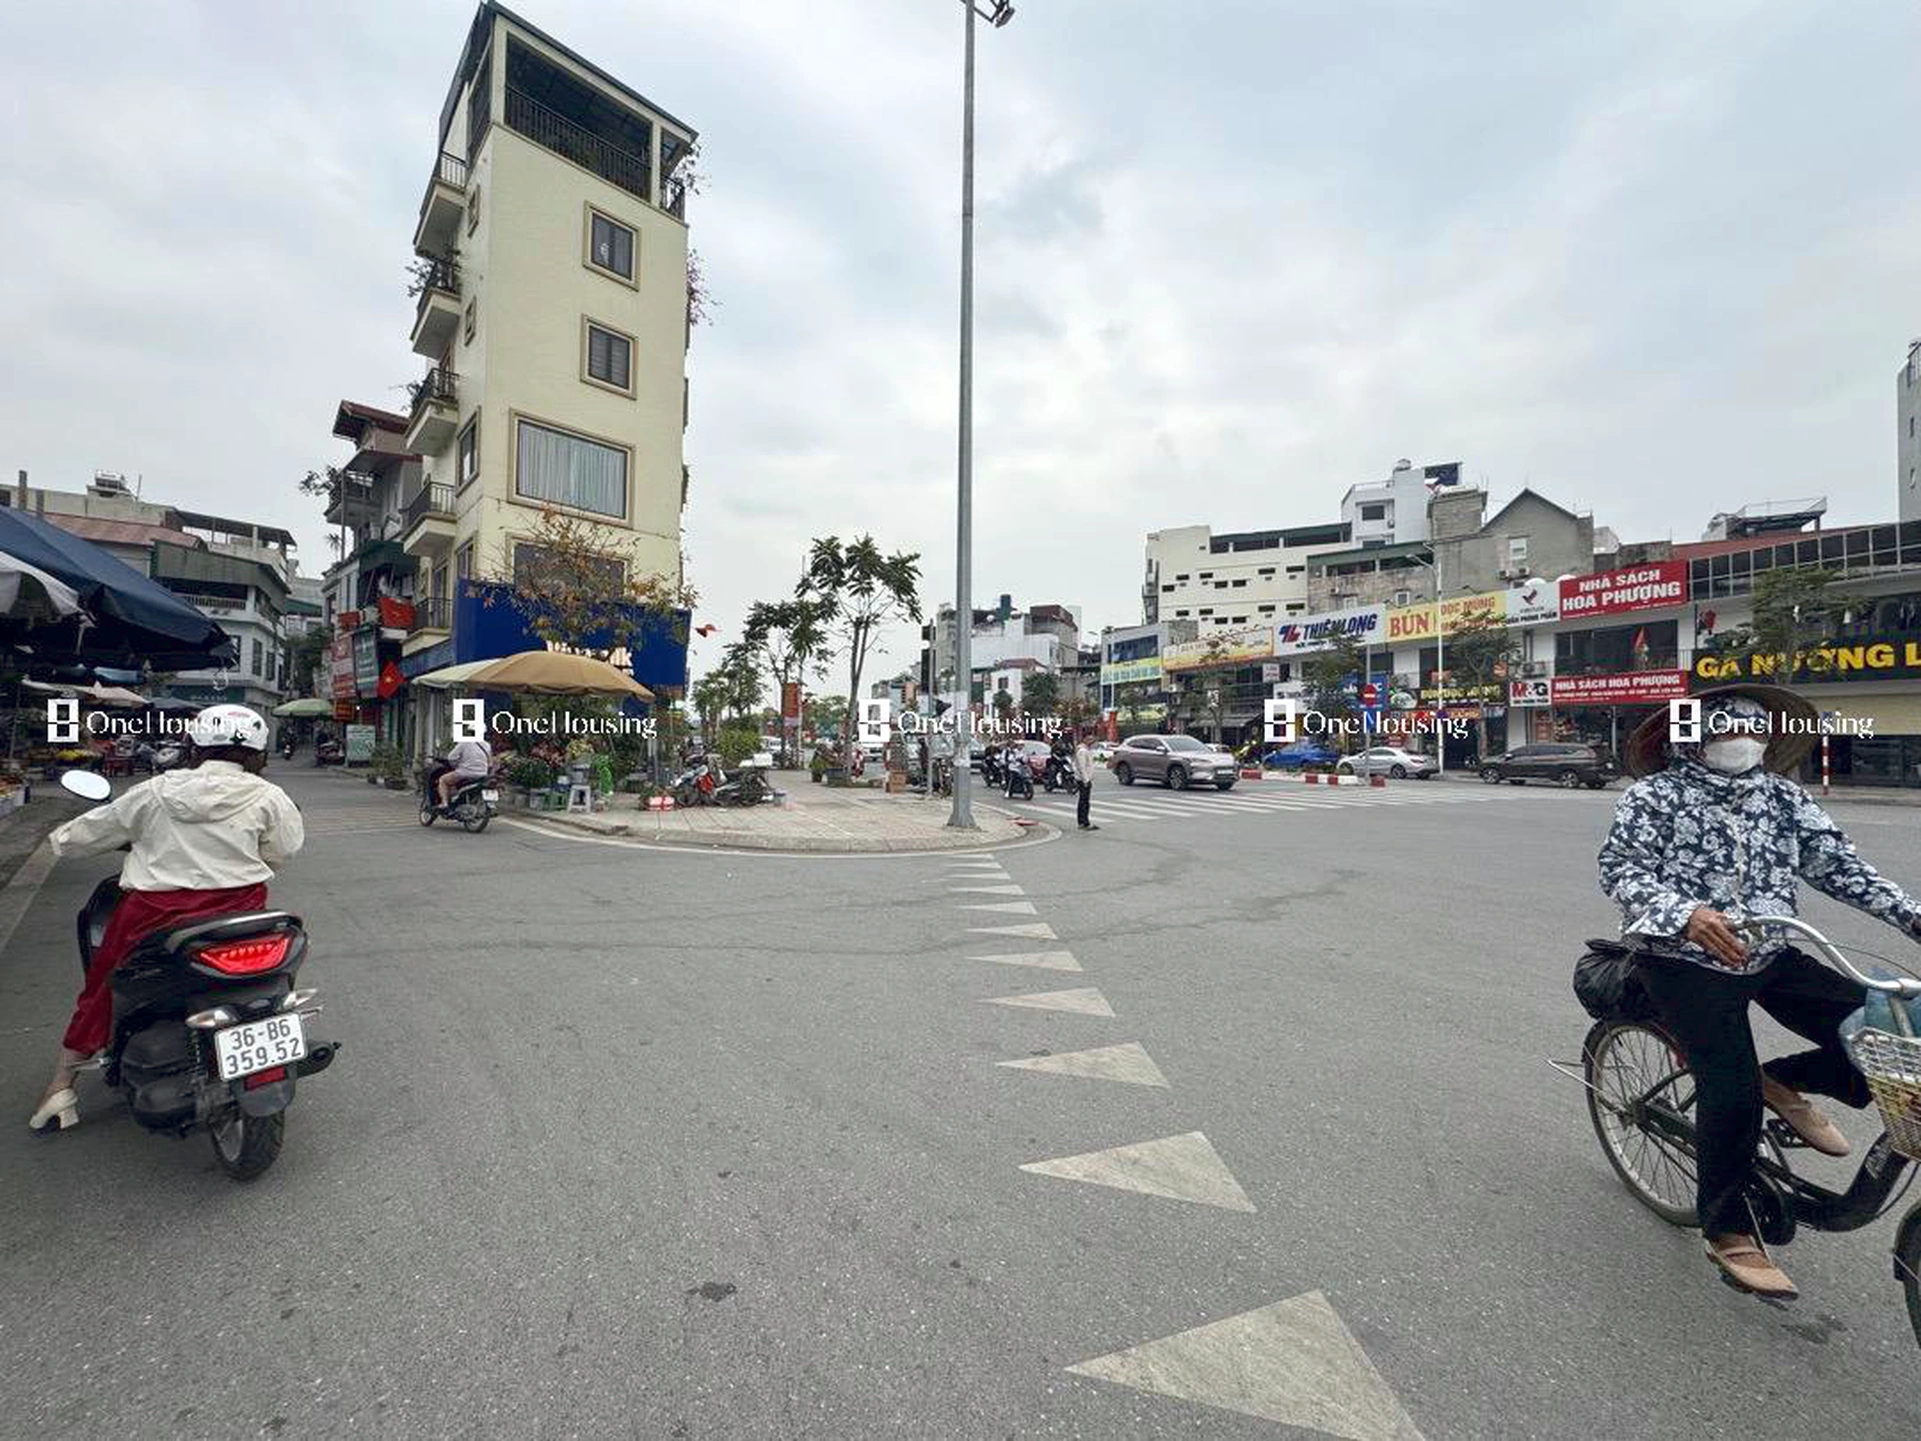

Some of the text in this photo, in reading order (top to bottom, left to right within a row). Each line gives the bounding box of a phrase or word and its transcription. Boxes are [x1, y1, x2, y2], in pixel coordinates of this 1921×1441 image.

[1563, 581, 1681, 611] HOA PHƯỢNG
[1579, 569, 1661, 593] NHÀ SÁCH
[1390, 609, 1430, 637] BÚN
[229, 1018, 291, 1050] 36-B6
[225, 1037, 302, 1075] 359.52
